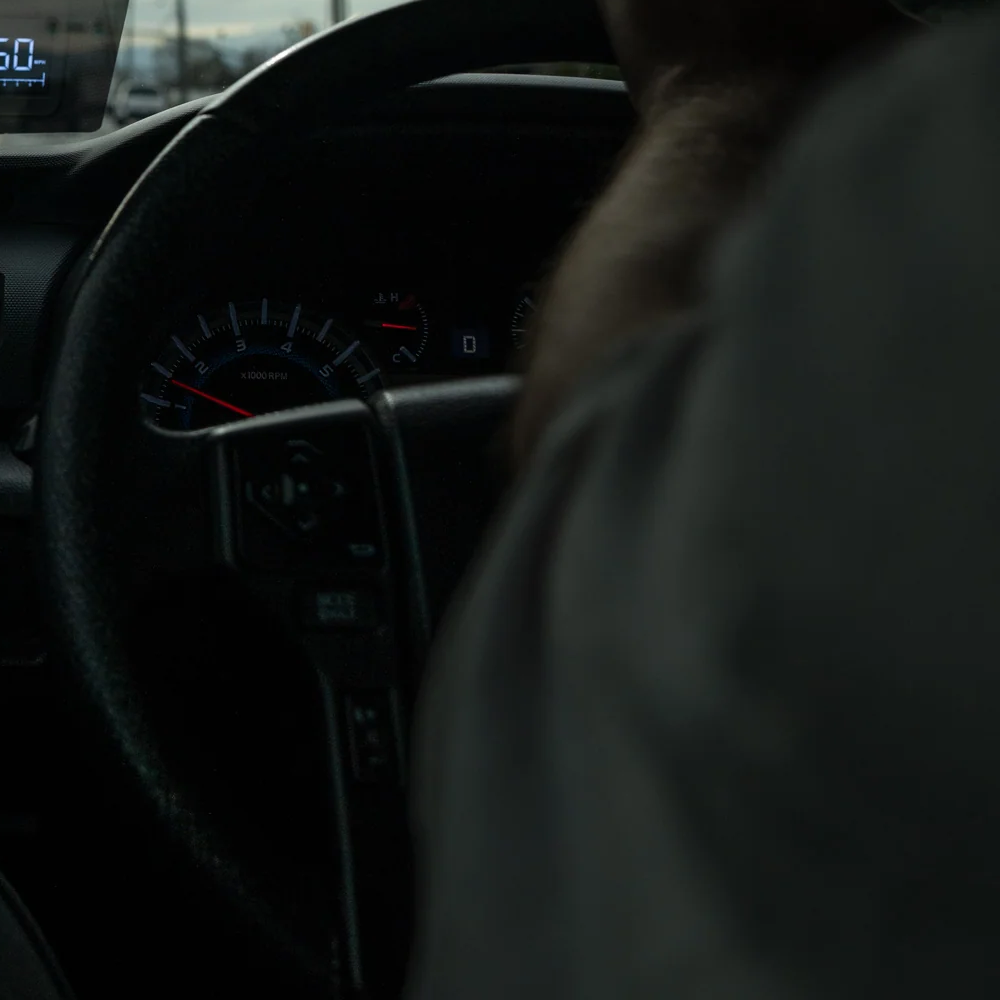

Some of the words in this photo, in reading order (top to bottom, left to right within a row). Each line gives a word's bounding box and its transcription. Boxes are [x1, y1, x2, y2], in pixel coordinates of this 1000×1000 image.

[390, 292, 399, 303] H
[235, 339, 247, 353] 3
[280, 341, 293, 354] 4
[392, 353, 402, 364] C
[194, 360, 209, 375] 2
[319, 363, 334, 378] 5
[269, 371, 288, 380] RPM
